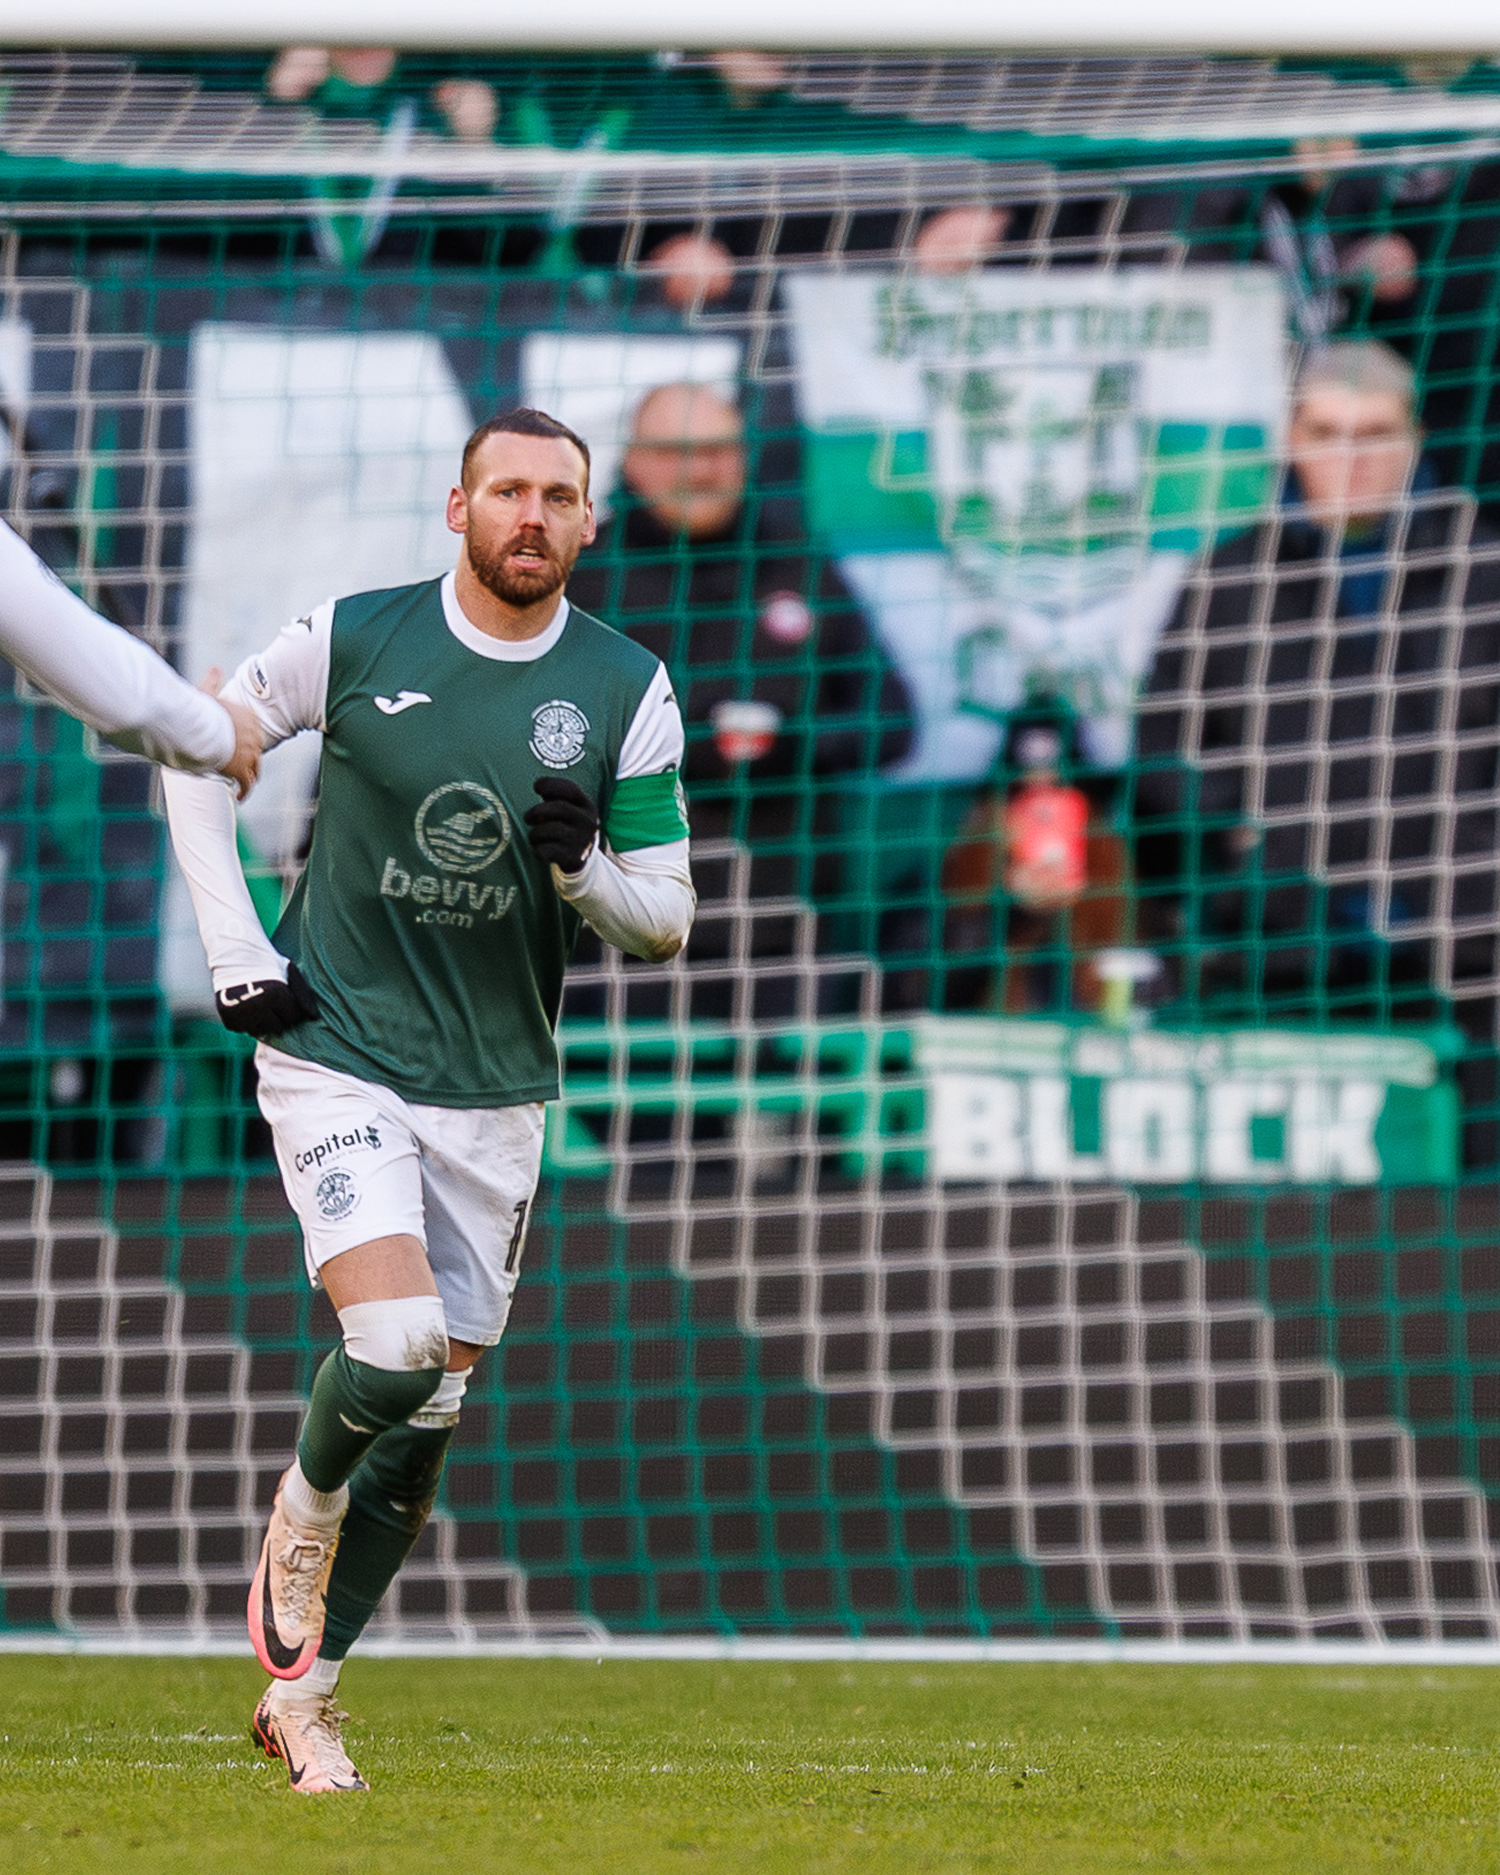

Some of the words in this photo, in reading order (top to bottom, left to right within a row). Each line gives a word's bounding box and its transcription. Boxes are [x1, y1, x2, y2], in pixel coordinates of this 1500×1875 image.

[379, 855, 519, 920] bevvy
[415, 909, 474, 929] .com
[294, 1128, 362, 1173] Capital
[930, 1070, 1386, 1184] BLOCK
